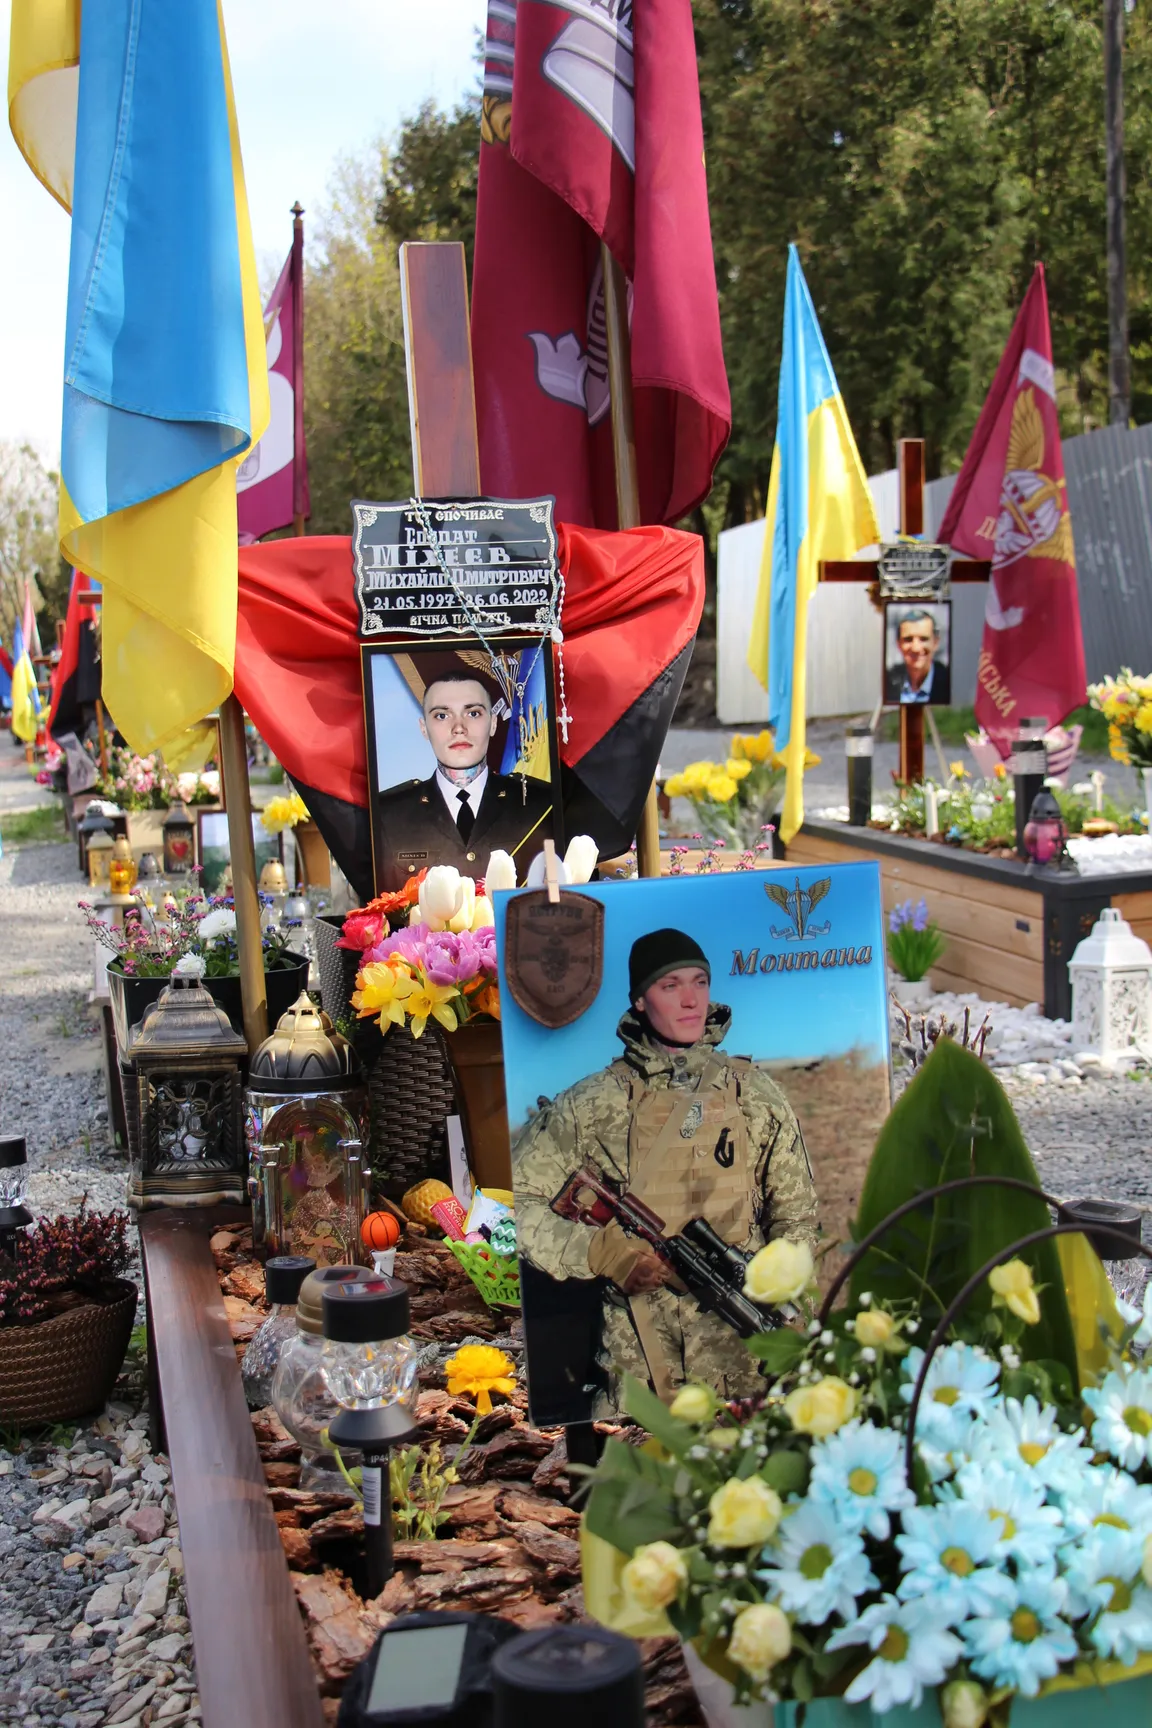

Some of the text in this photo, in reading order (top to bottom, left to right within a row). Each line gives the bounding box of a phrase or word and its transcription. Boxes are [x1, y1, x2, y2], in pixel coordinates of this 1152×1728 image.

[373, 593, 456, 610] 21.05.1997
[452, 612, 511, 625] ПАМЯТЬ
[729, 945, 872, 976] Монтана
